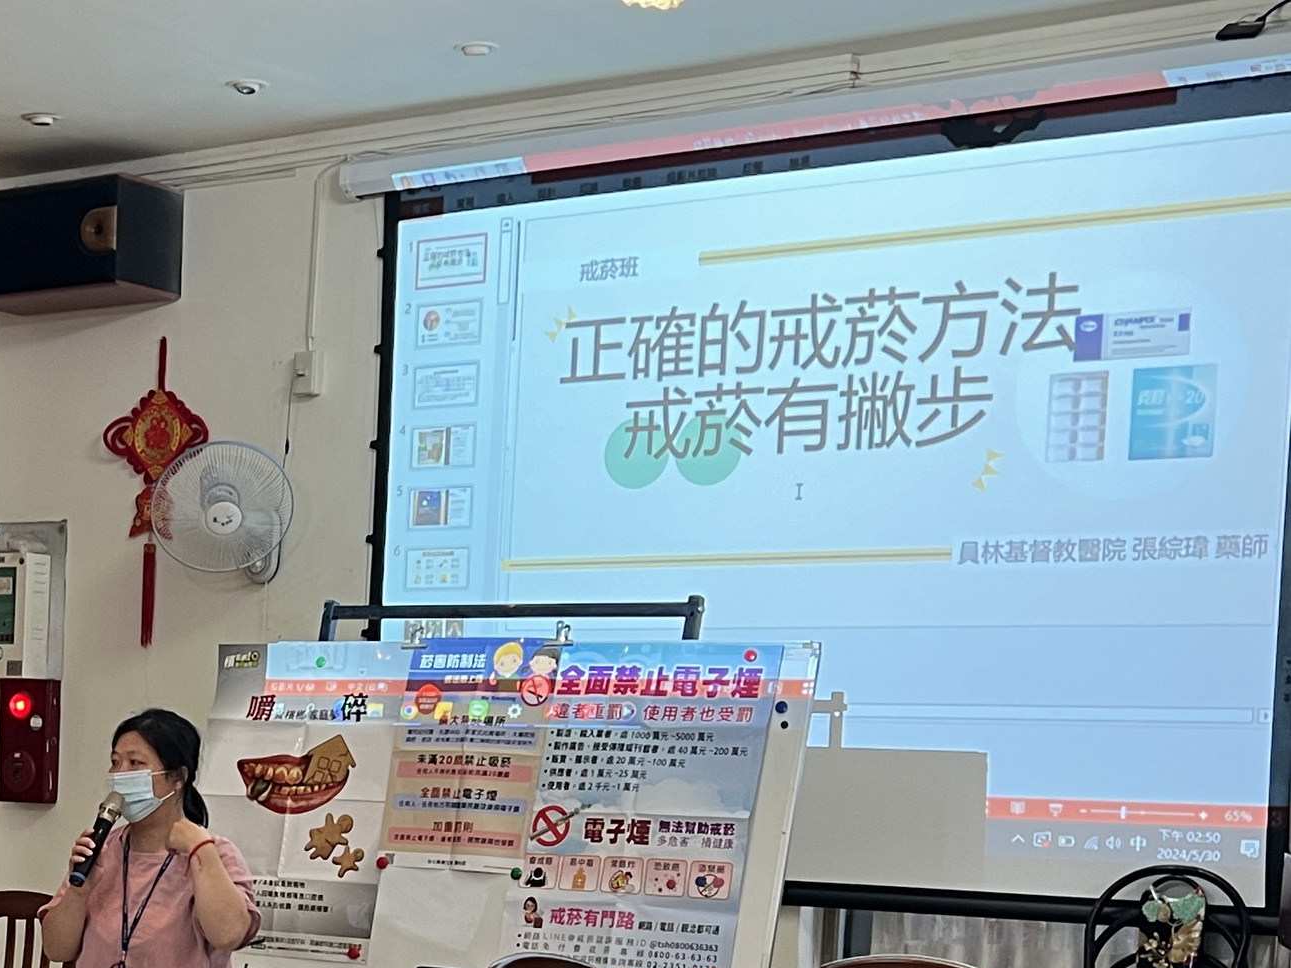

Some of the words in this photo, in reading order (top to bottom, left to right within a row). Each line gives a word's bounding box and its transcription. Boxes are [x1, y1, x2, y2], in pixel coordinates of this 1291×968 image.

[580, 257, 639, 281] 戒菸班
[405, 303, 412, 315] 2
[559, 272, 1082, 385] 正確的戒菸方法
[402, 364, 409, 376] 3
[623, 367, 994, 460] 戒菸有撇步
[399, 425, 406, 435] 4
[396, 486, 403, 496] 5
[394, 545, 401, 556] 6
[958, 537, 1127, 565] 員林基督教醫院
[1132, 535, 1209, 561] 張綜瑋
[1215, 534, 1269, 560] 藥師
[420, 653, 486, 669] 菸害防制法
[556, 665, 763, 699] 全面禁止電子煙
[342, 693, 369, 722] 碎
[553, 702, 624, 721] 違者重罰
[643, 703, 754, 723] 使用者也受罰
[631, 731, 650, 740] 1000
[652, 731, 669, 741] 萬元
[697, 732, 714, 742] 萬元
[678, 746, 688, 754] 40
[690, 746, 707, 755] 萬元
[731, 746, 748, 757] 萬元
[416, 754, 512, 769] 未滿20歲禁止吸菸
[616, 756, 626, 764] 20
[628, 756, 645, 766] 萬元
[668, 758, 686, 768] 萬元
[596, 769, 613, 778] 萬元
[630, 770, 647, 779] 萬元
[420, 787, 498, 801] 全面禁止電子煙
[594, 782, 610, 791] 千元
[622, 782, 639, 792] 萬元
[1224, 809, 1253, 823] 65%
[432, 821, 474, 833] 加重罰則
[584, 818, 651, 846] 電子煙
[658, 819, 735, 836] 無法幫助戒菸
[1130, 835, 1147, 851] 中
[1159, 828, 1183, 842] 下午
[1186, 831, 1221, 844] 02:50
[1157, 848, 1221, 863] 2024/5/30
[550, 907, 635, 930] 戒菸有門路
[649, 940, 719, 952] @tsh0800636363
[648, 950, 717, 963] 0800-63-63-63
